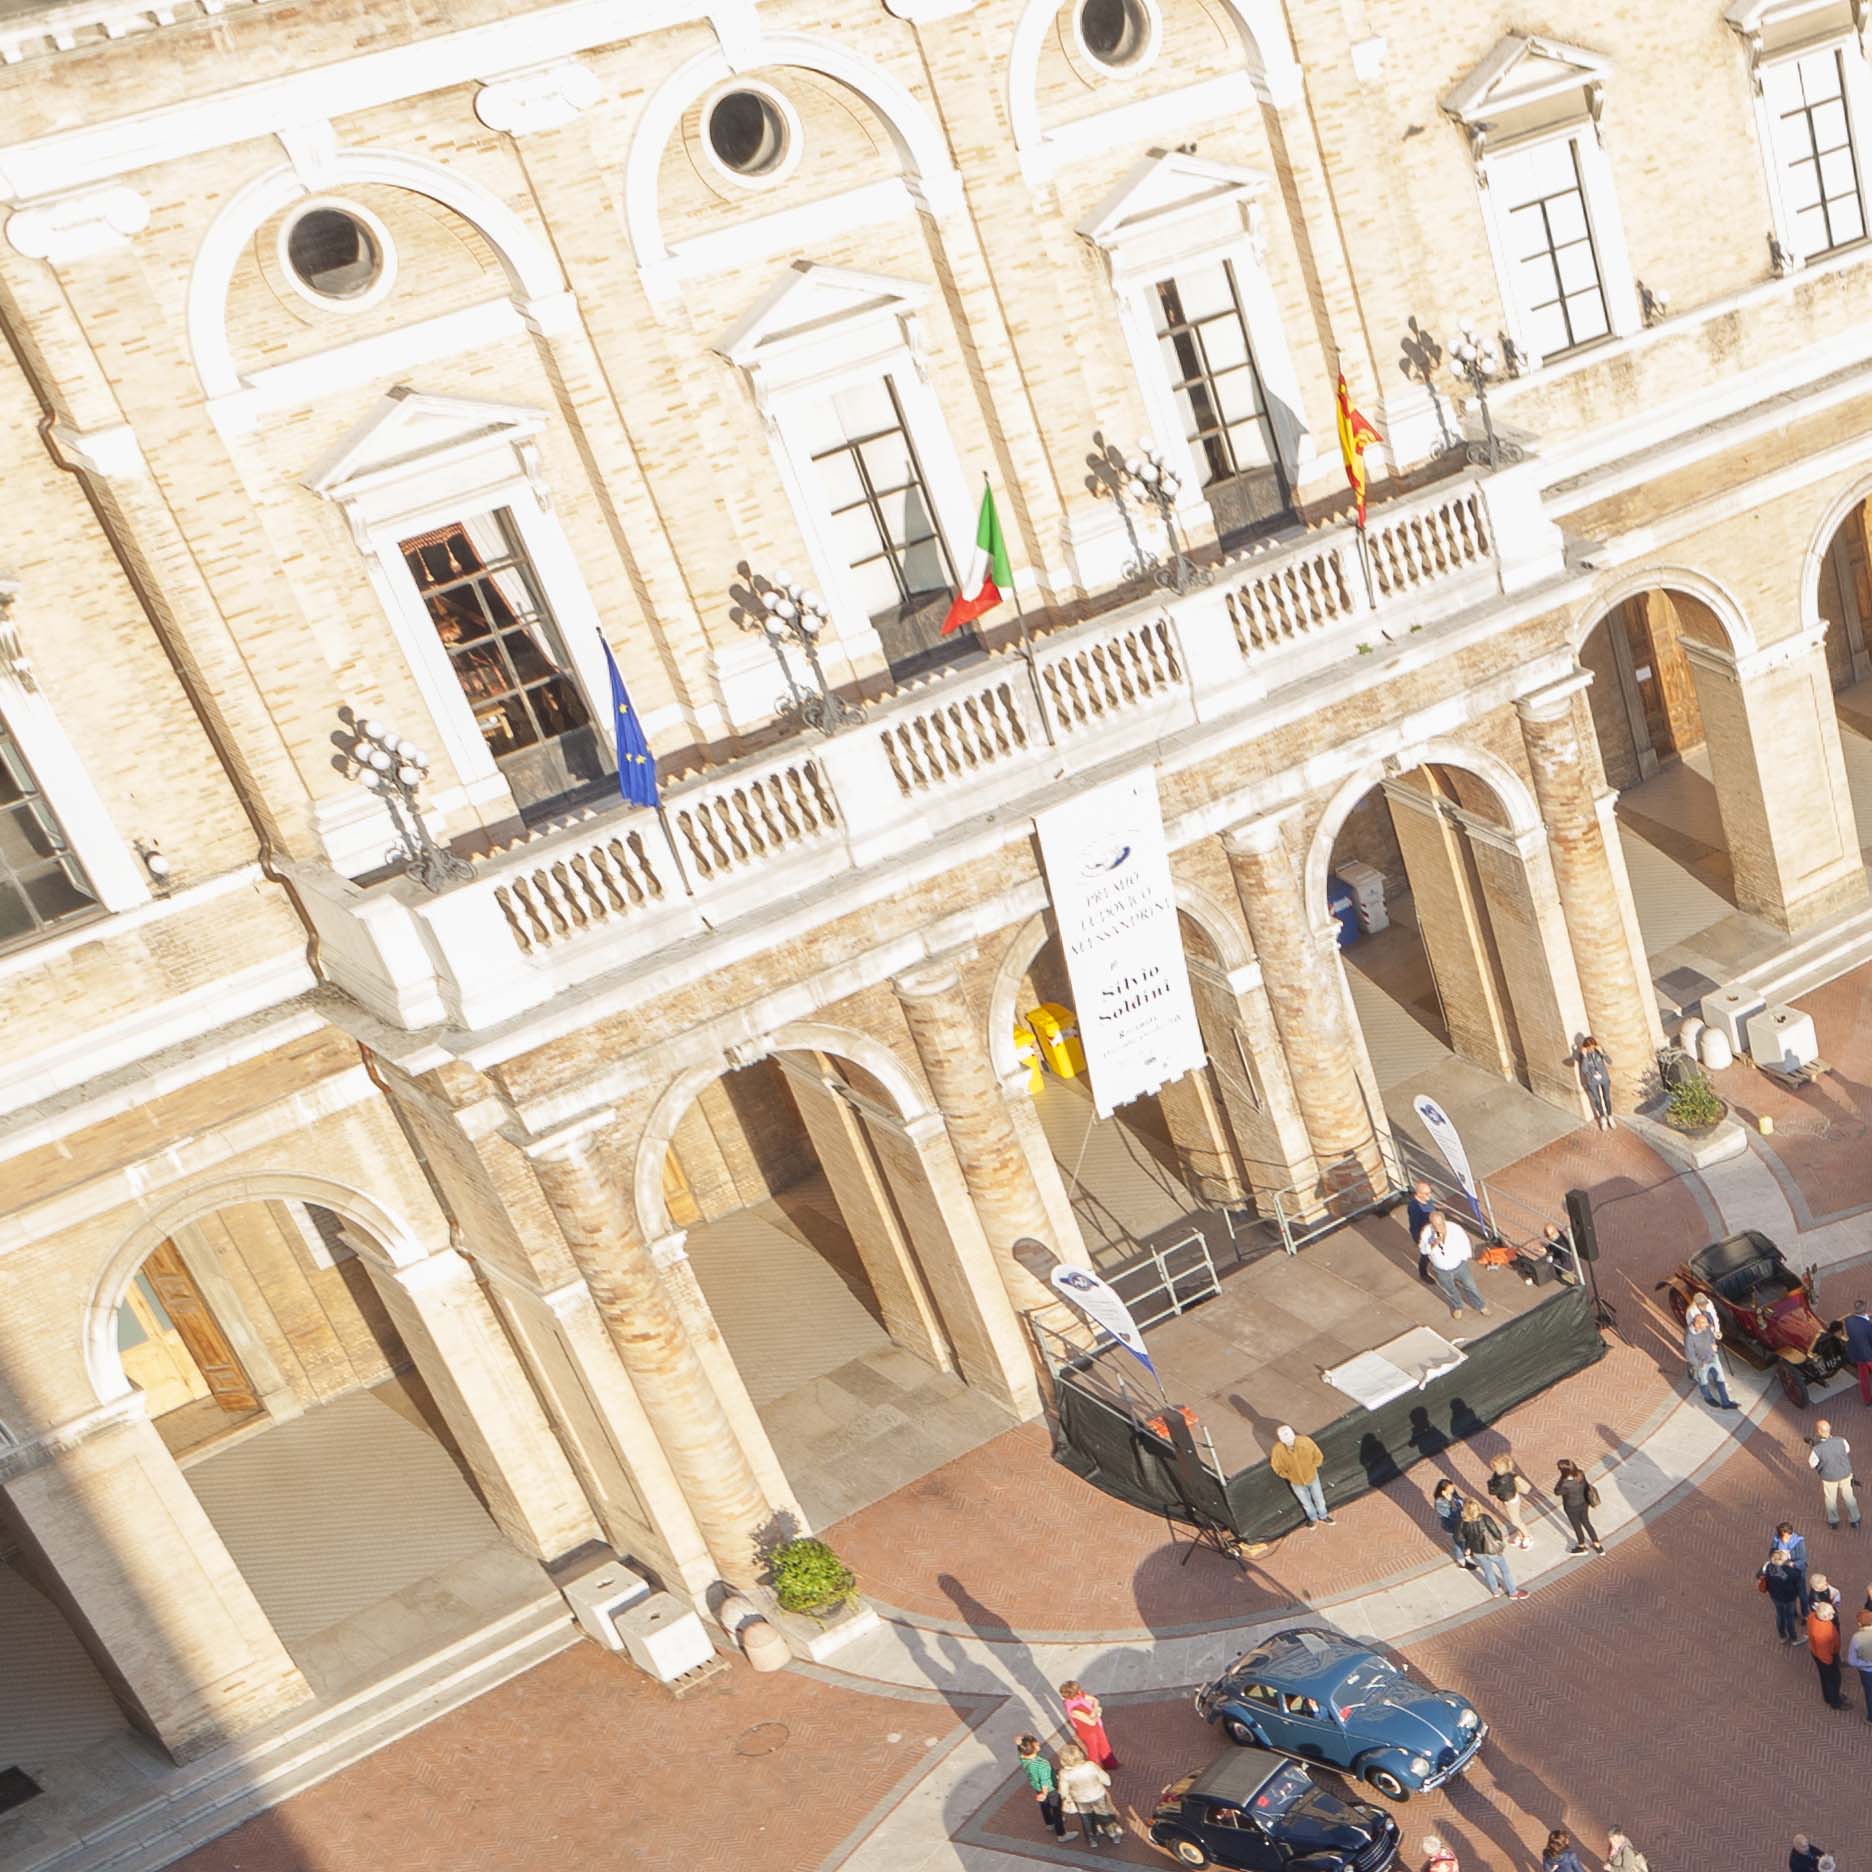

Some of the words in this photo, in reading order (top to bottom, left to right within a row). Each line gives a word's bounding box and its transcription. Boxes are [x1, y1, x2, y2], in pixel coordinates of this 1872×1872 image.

[1079, 887, 1153, 931] LUDOVICO
[1085, 871, 1142, 908] PREMIO
[1097, 979, 1171, 1024] Soldini
[1100, 965, 1161, 1001] Silvio
